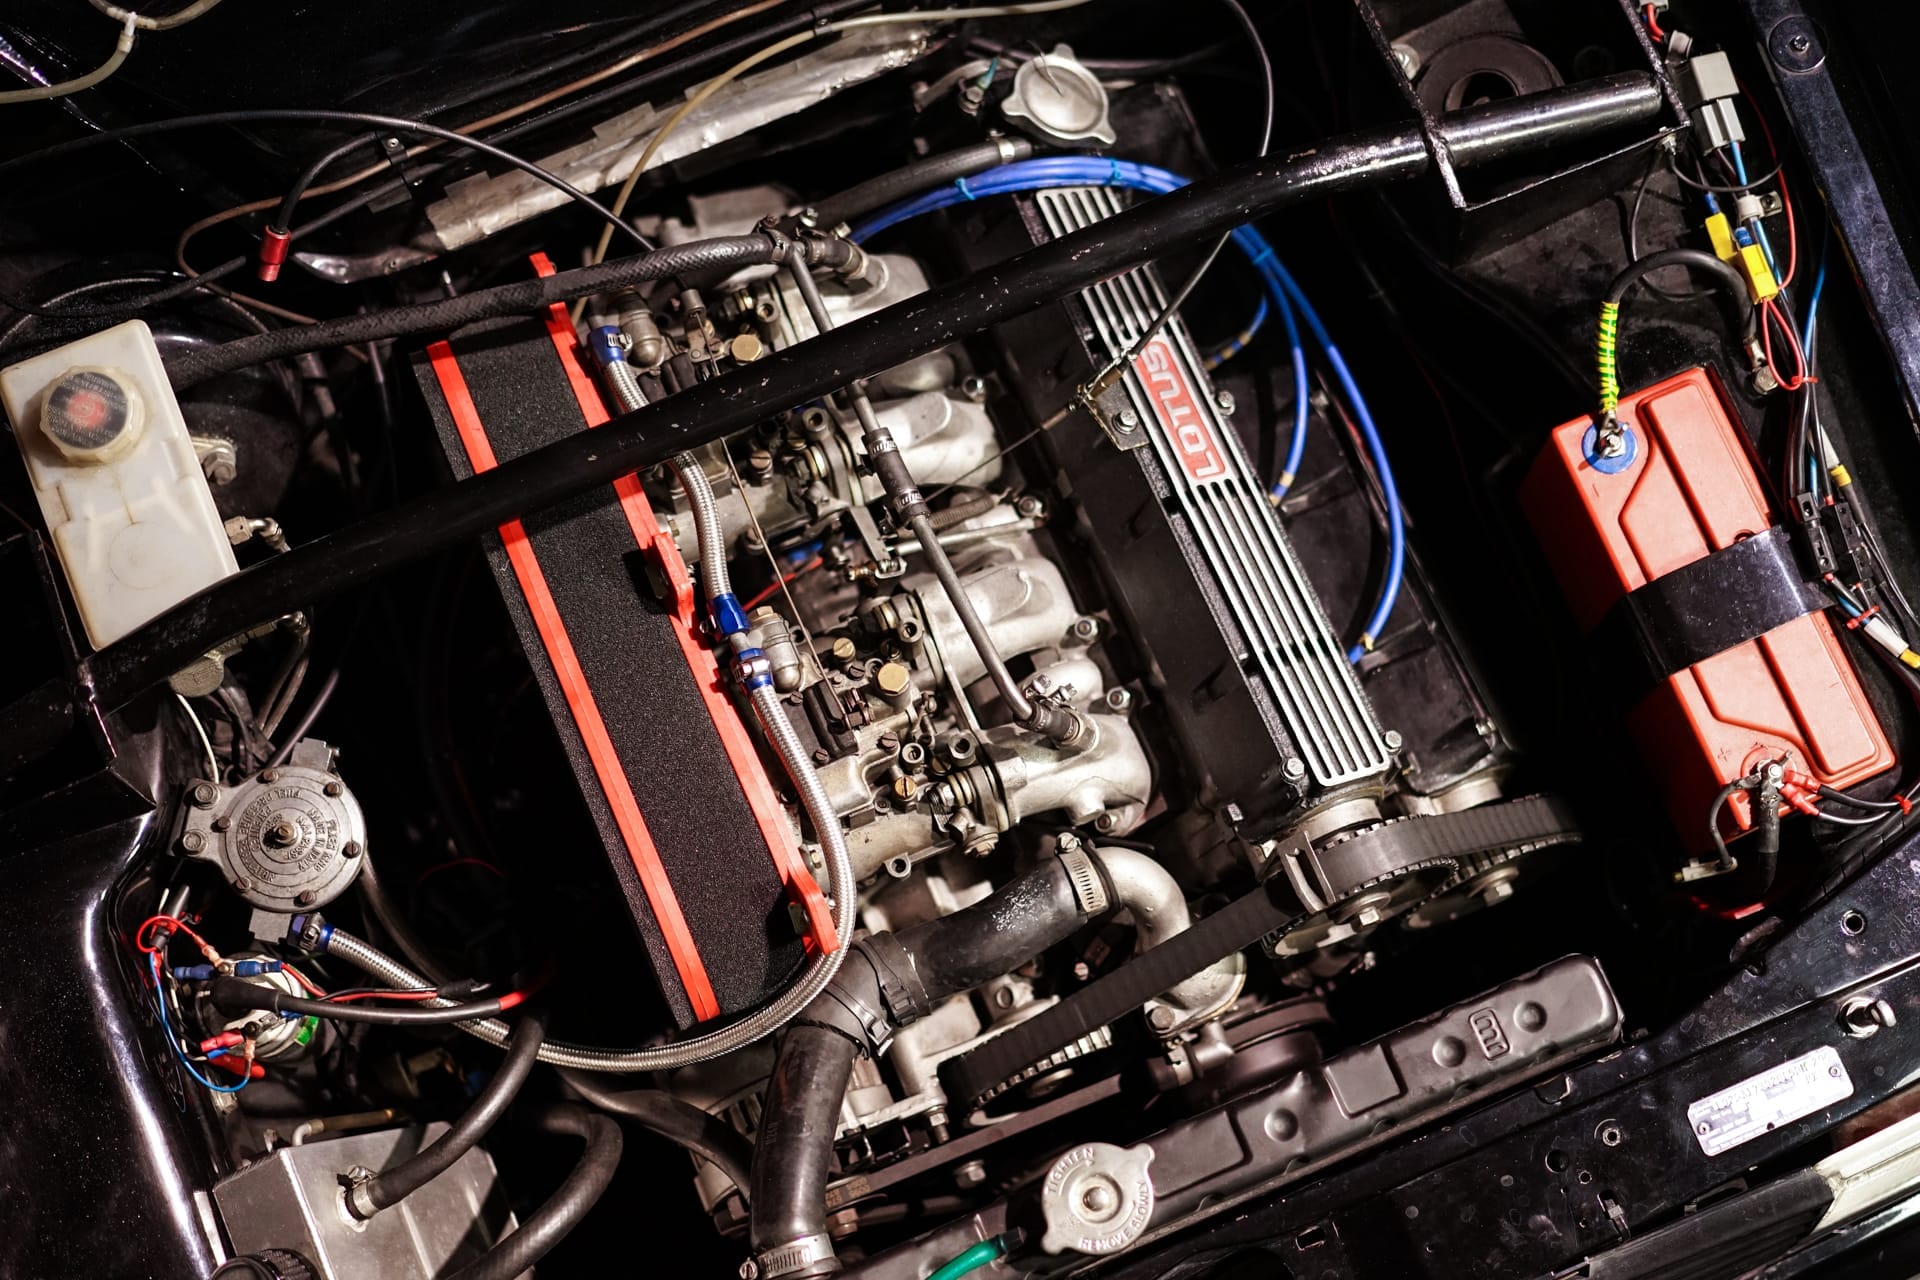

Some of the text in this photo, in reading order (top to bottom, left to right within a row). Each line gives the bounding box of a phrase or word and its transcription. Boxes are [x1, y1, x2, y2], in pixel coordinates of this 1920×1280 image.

[1140, 343, 1220, 477] LOTUS
[239, 793, 273, 835] PRESSURE
[273, 788, 301, 800] FUEL
[307, 808, 326, 836] MADE
[315, 838, 326, 848] IN
[1046, 1146, 1095, 1194] TIGHTEN
[1079, 1180, 1149, 1252] REMOVE SLOWLY
